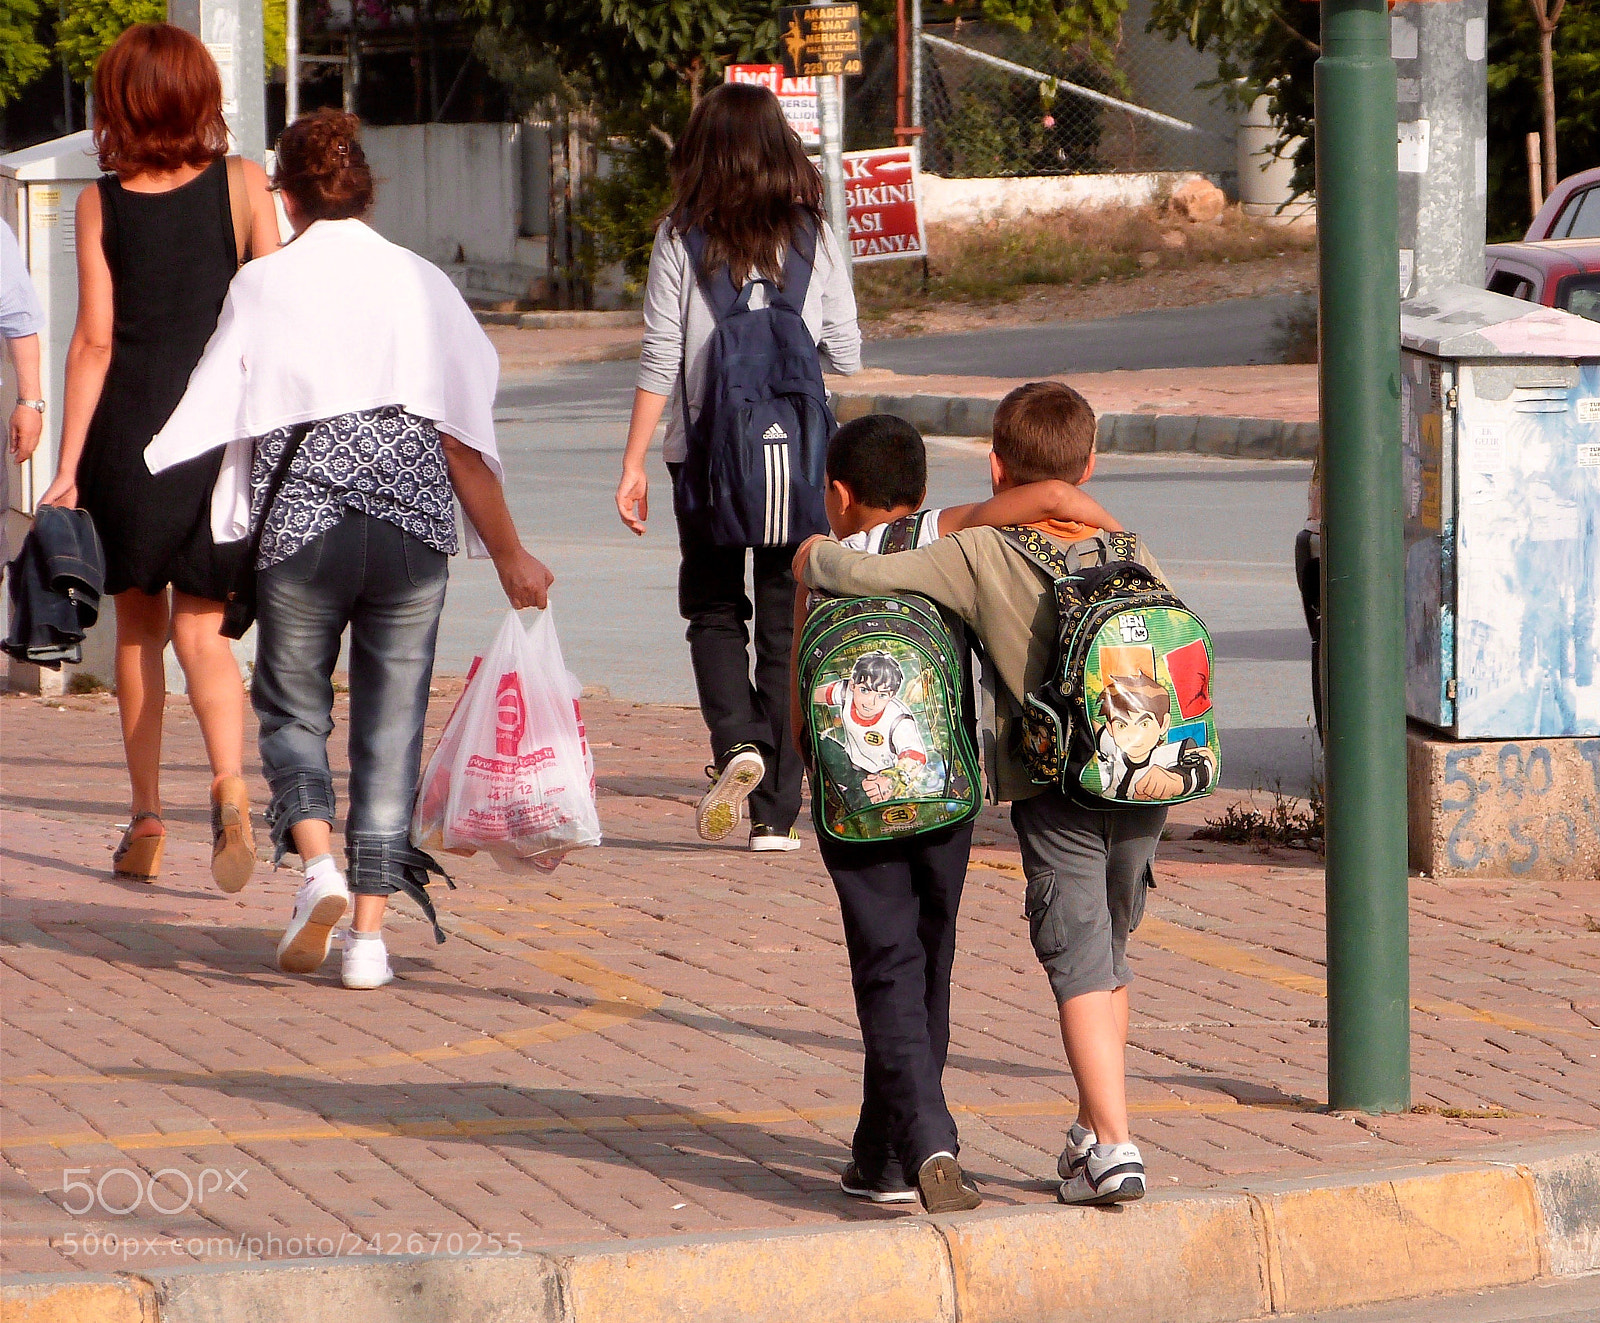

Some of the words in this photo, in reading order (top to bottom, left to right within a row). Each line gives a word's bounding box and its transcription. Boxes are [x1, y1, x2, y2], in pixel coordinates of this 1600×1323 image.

[804, 4, 856, 20] AKADEMİ
[811, 20, 849, 31] SANAT
[806, 30, 856, 43] MERKEZİ
[826, 61, 841, 72] 02
[845, 60, 860, 72] 40
[851, 234, 920, 257] PANYA
[762, 432, 788, 440] adidas
[1117, 614, 1146, 628] BEN
[1119, 627, 1149, 643] 10
[518, 784, 533, 795] 12
